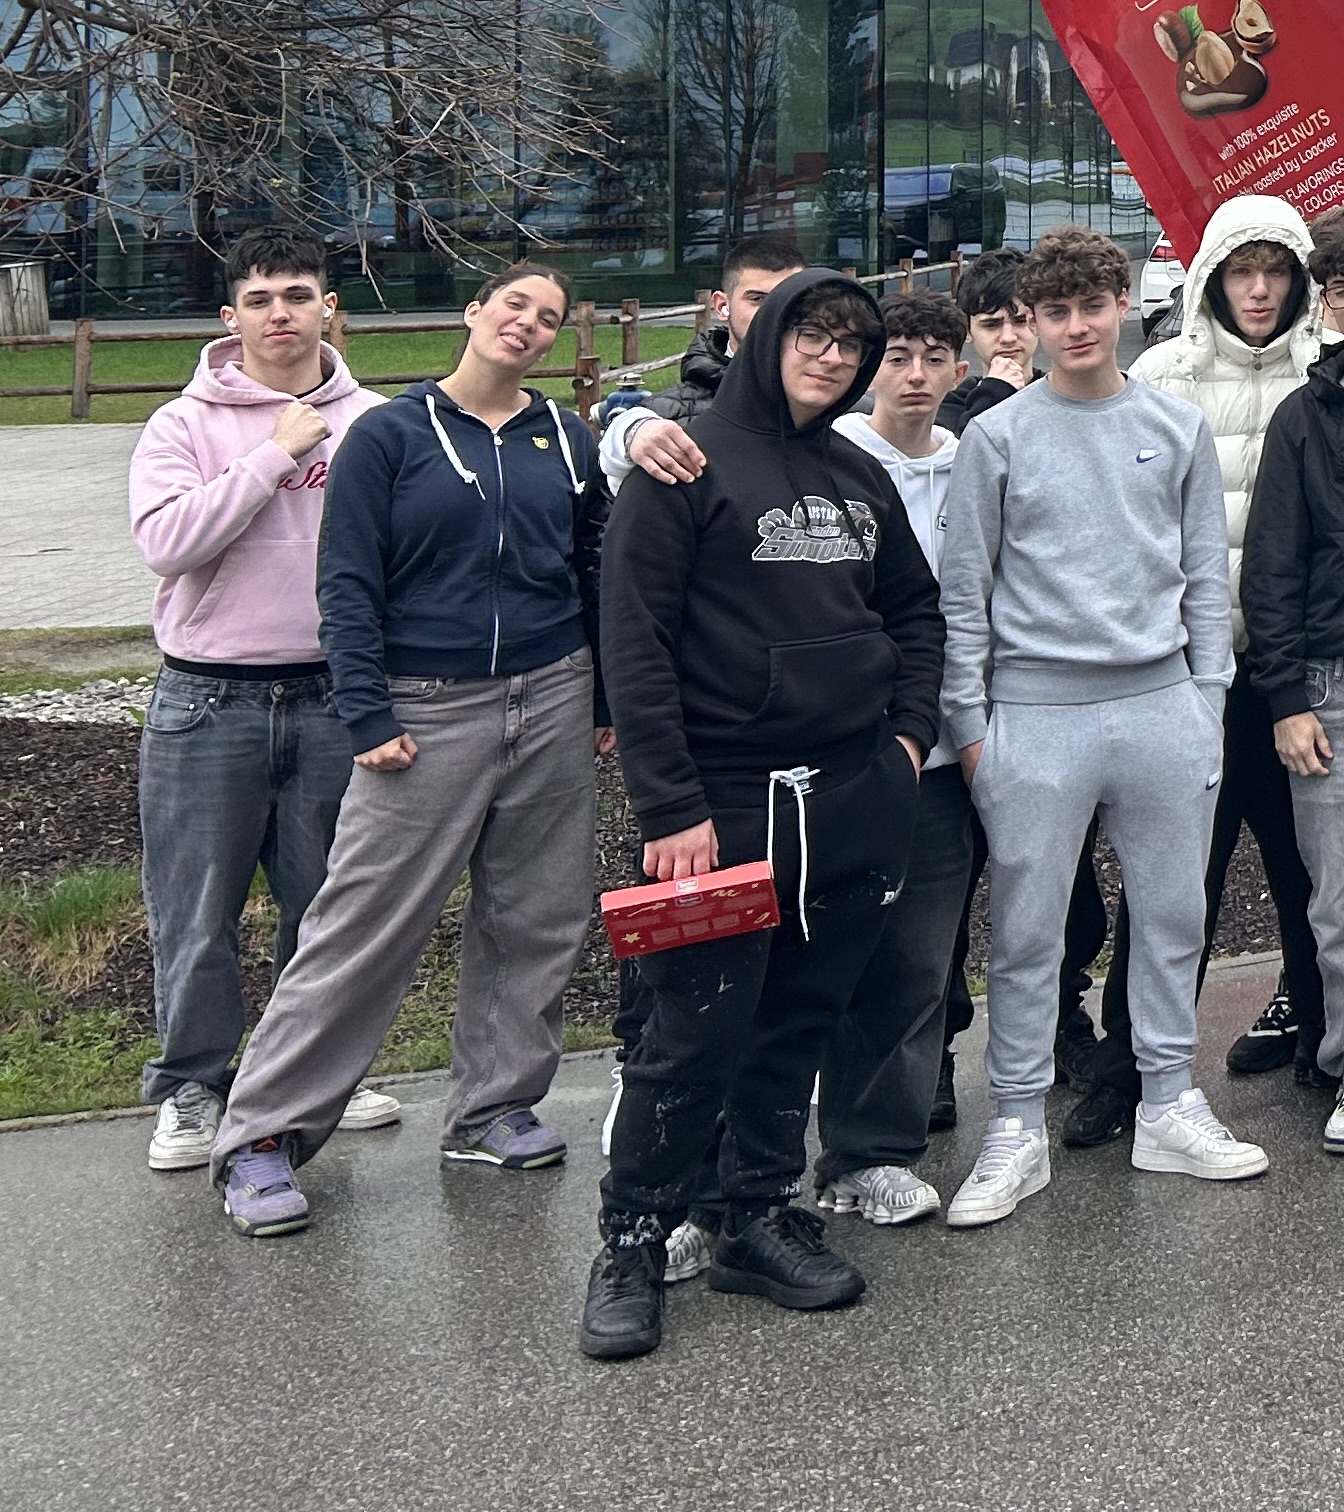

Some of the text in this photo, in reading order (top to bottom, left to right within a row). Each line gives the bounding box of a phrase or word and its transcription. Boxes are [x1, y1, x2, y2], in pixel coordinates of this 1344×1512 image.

[1212, 108, 1331, 195] ITALIAN HAZELNUTS
[1218, 102, 1300, 161] with 100% exquisite
[1253, 167, 1286, 195] roasted
[1285, 158, 1300, 173] by
[1298, 132, 1338, 165] Loacker
